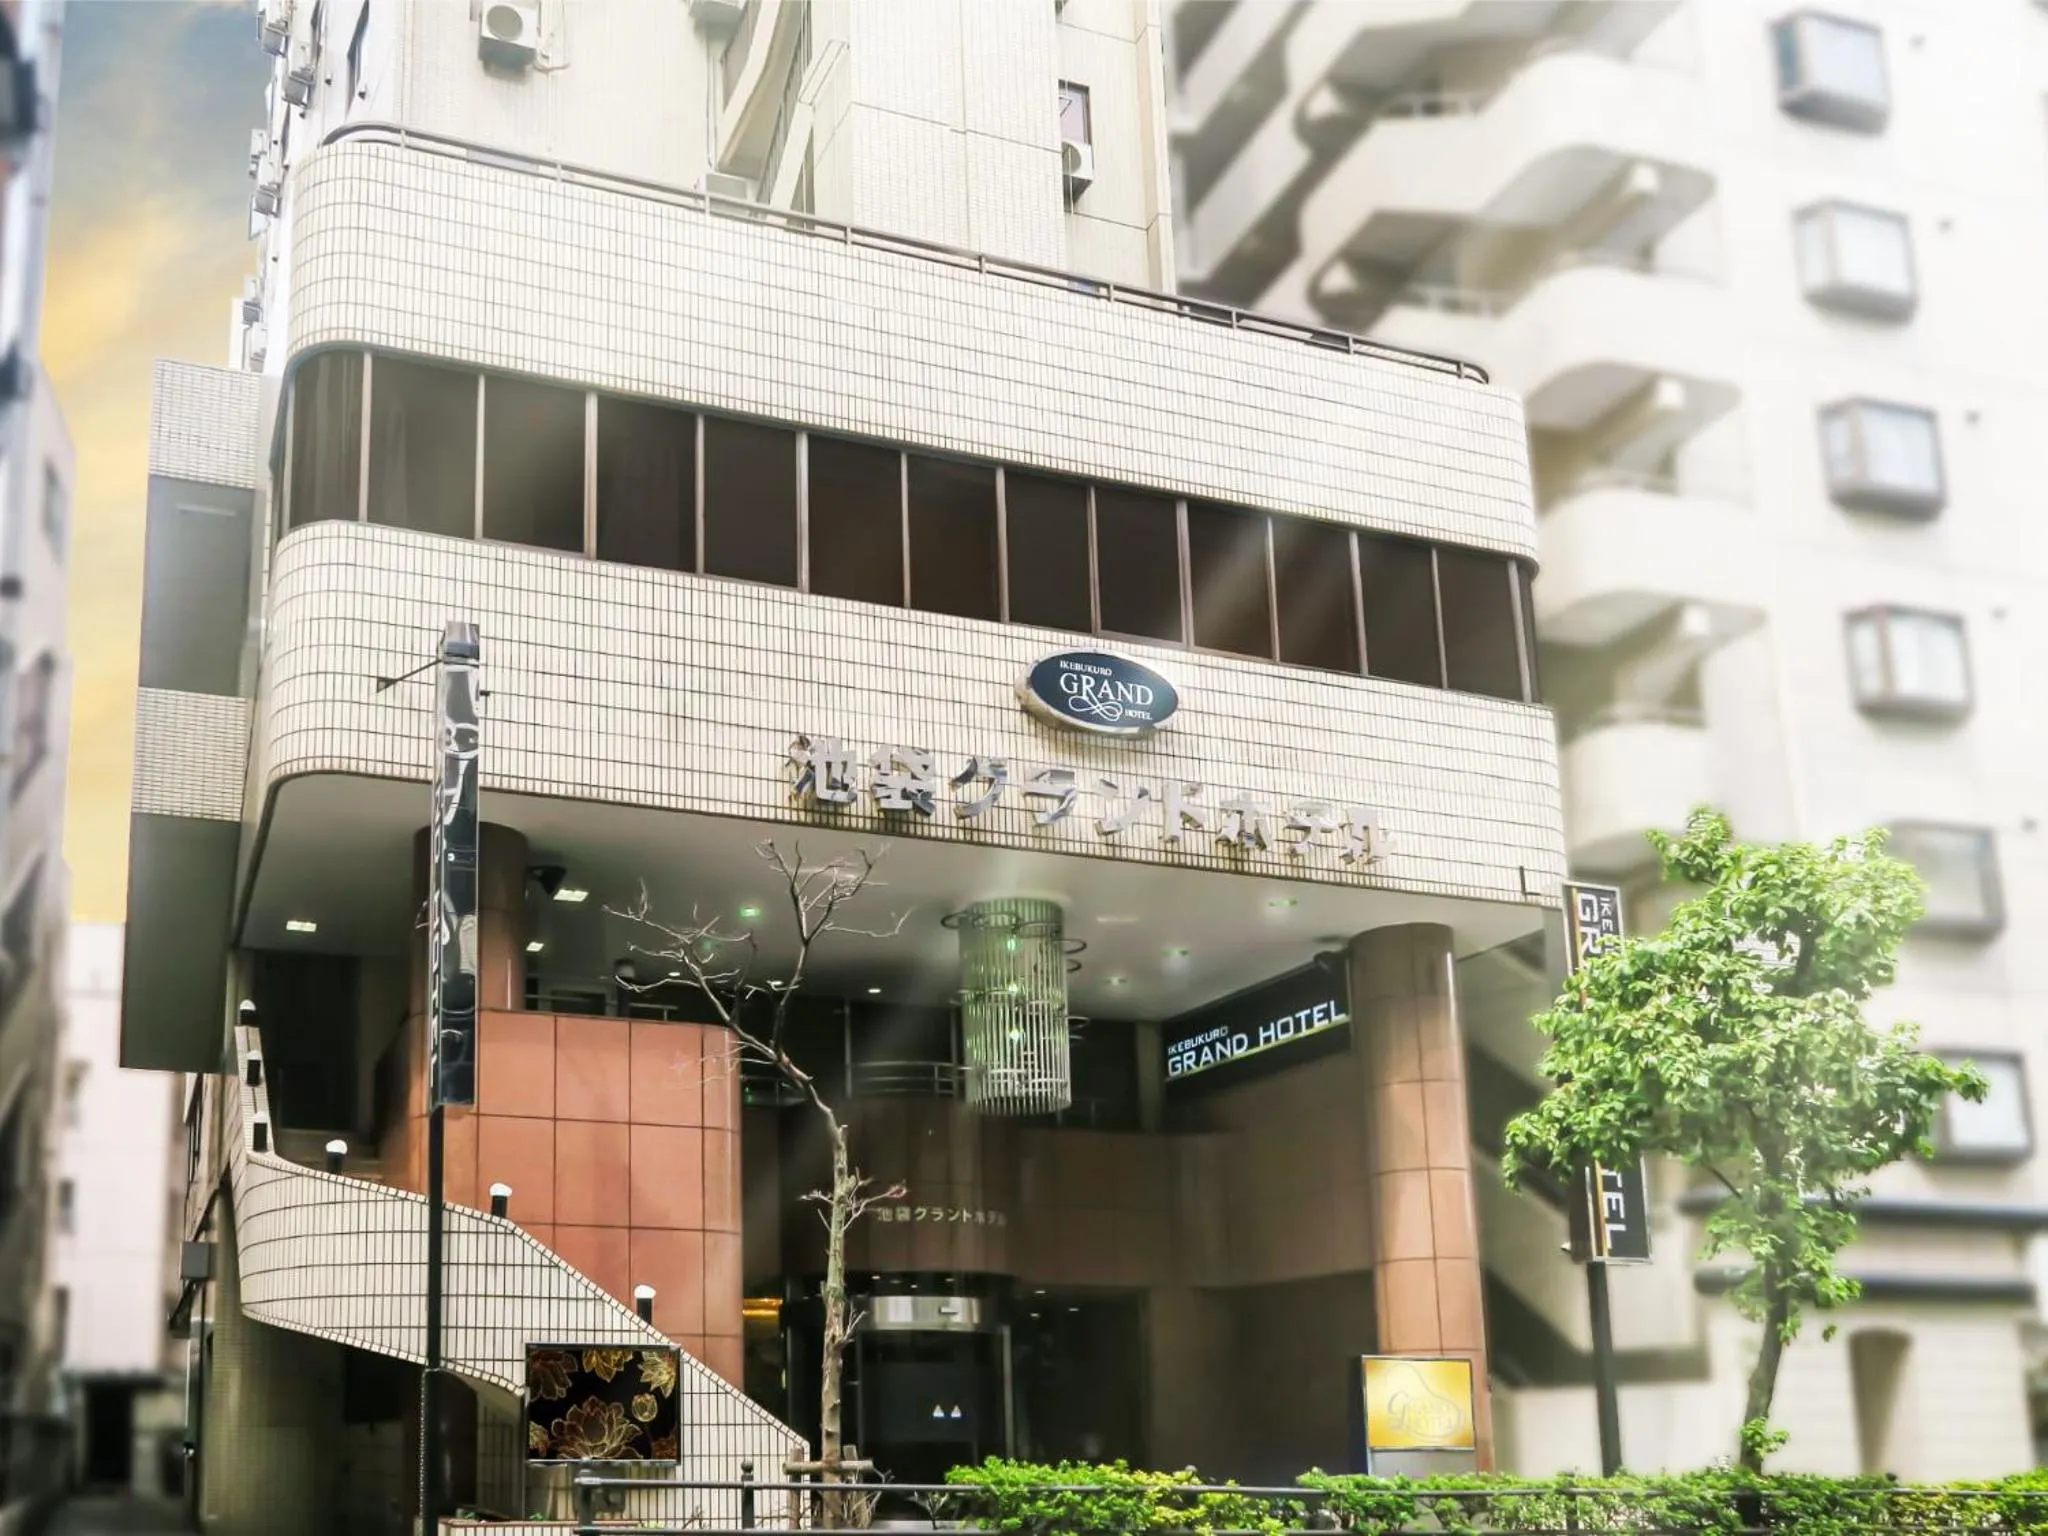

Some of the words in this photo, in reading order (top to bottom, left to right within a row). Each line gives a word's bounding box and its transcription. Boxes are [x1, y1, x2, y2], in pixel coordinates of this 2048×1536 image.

[1060, 660, 1112, 676] IKEBUKURO
[1060, 673, 1154, 706] GRAND
[1125, 709, 1153, 720] HOTEL
[786, 734, 1397, 866] 池袋グランドホテル
[1168, 1033, 1248, 1078] GRAND
[1259, 1000, 1347, 1049] HOTEL
[1168, 1025, 1229, 1054] IKEBUKURO
[1600, 1168, 1626, 1249] TEL
